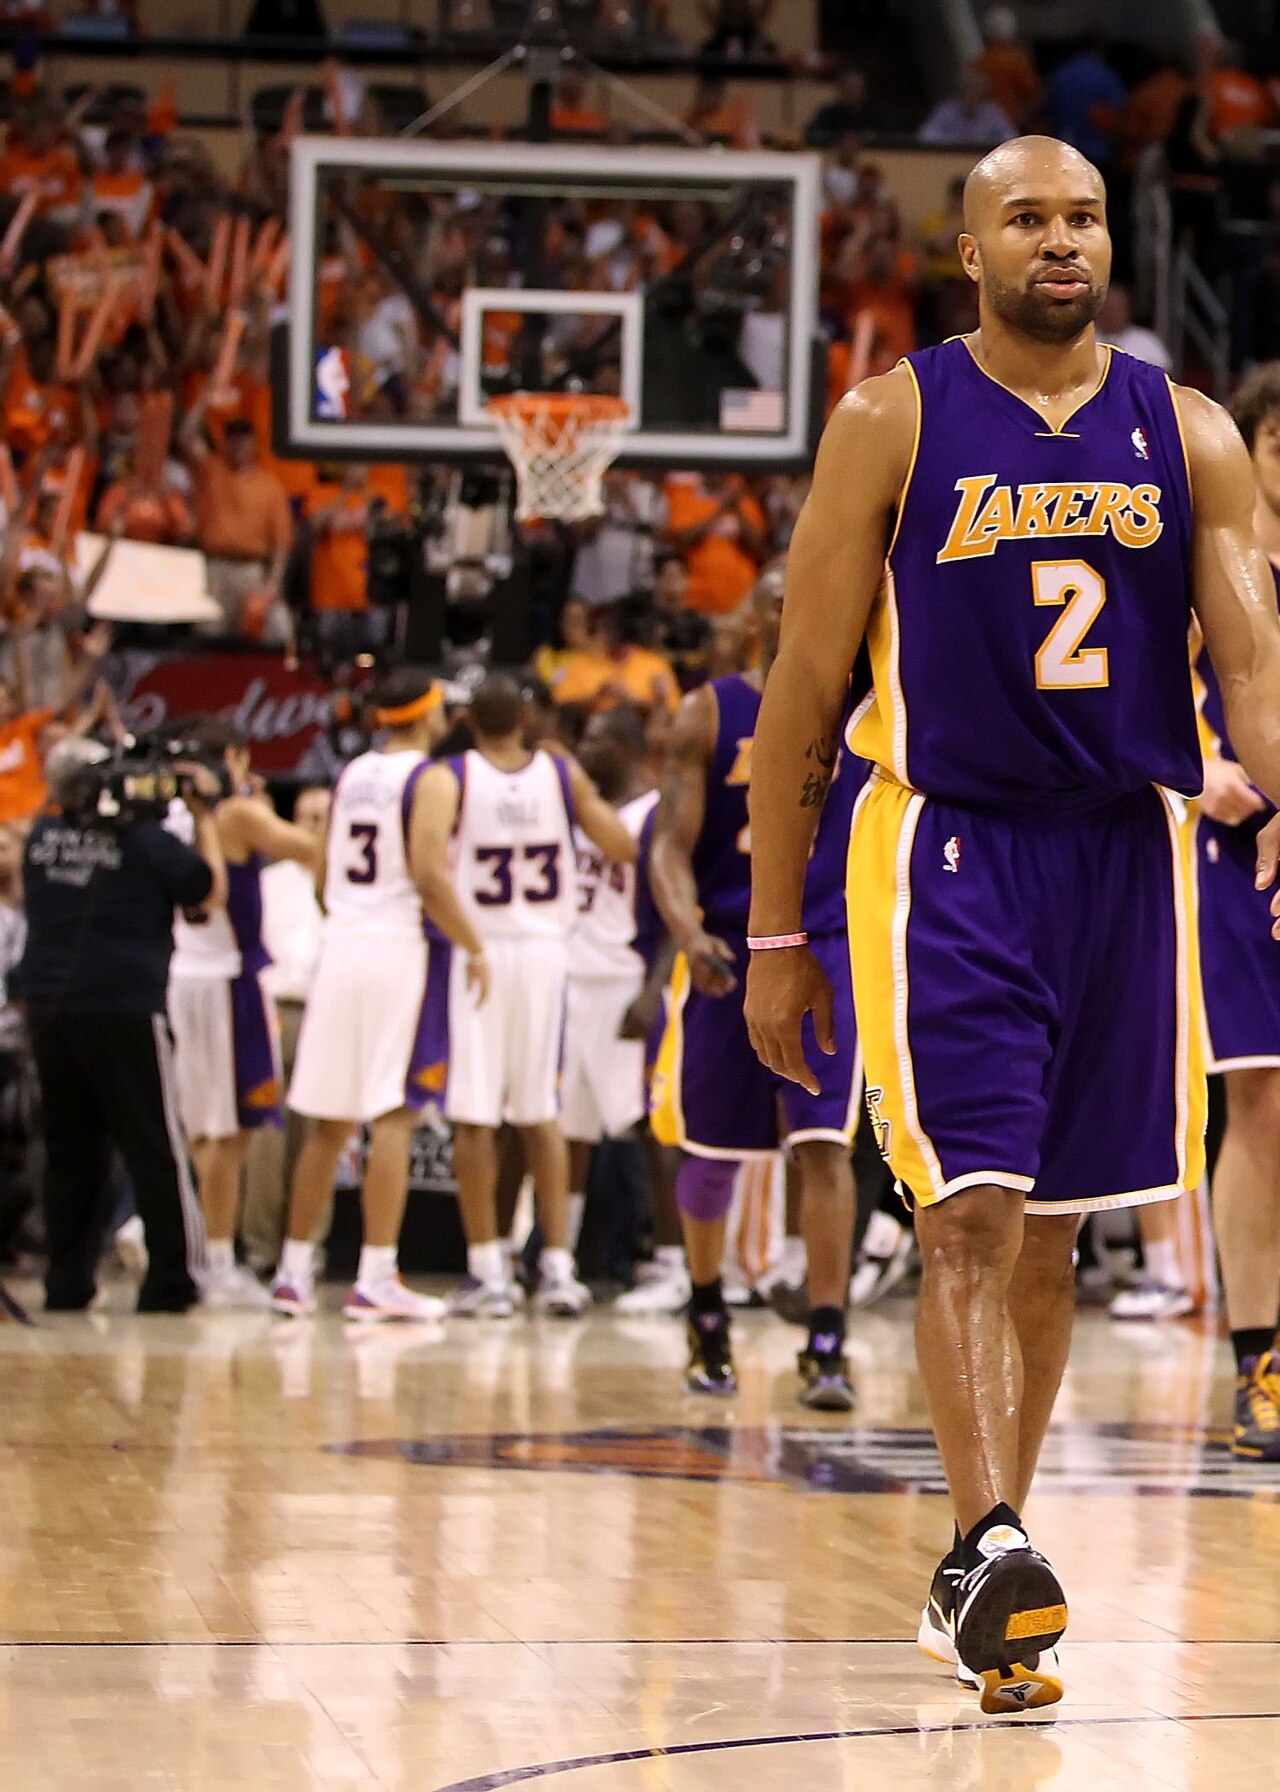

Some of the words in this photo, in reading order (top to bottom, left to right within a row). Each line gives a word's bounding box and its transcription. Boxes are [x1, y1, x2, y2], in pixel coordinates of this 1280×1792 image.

[936, 473, 1163, 564] LAKERS
[1031, 560, 1110, 690] 2
[347, 823, 378, 885] 3
[475, 843, 560, 906] 33
